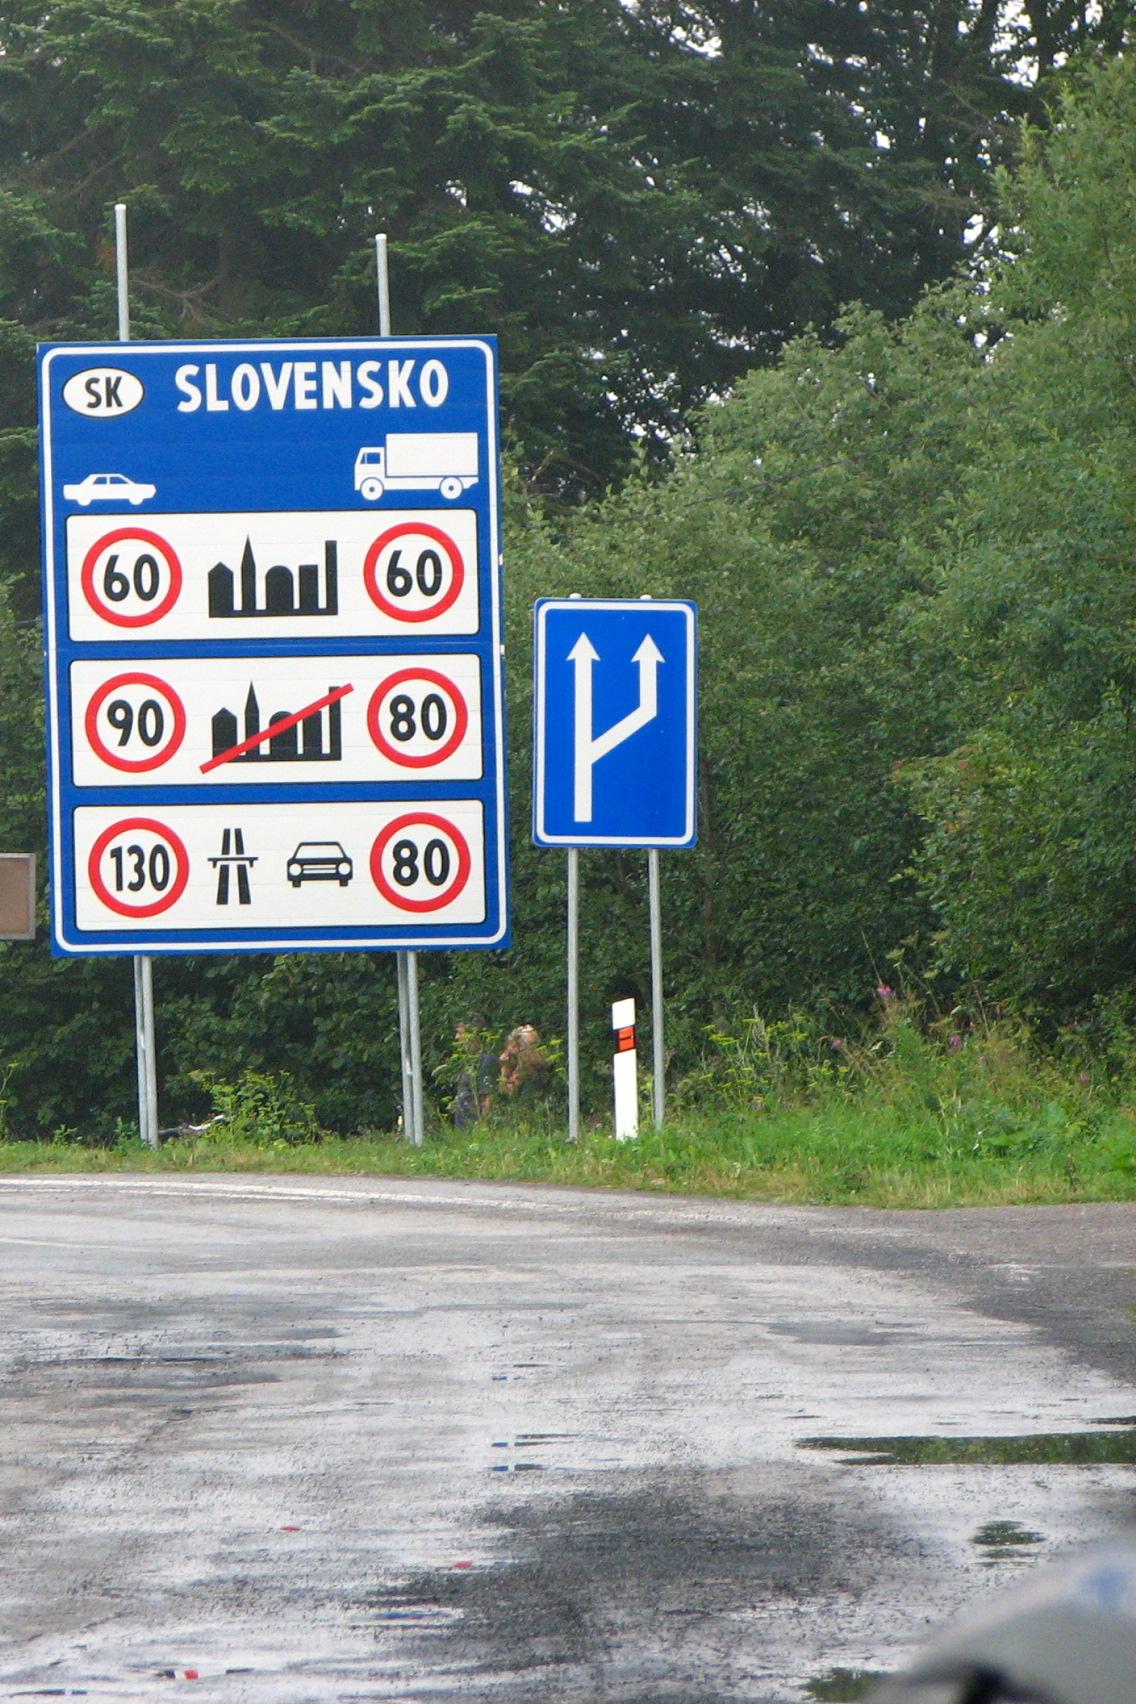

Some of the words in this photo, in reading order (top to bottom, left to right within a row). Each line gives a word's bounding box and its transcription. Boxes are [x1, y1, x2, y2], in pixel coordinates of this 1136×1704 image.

[84, 375, 124, 409] SK
[174, 358, 450, 412] SLOVENSKO
[103, 553, 160, 602] 60
[386, 549, 443, 597] 60
[107, 698, 165, 747] 90
[389, 693, 448, 742] 80
[110, 843, 170, 892] 130
[392, 838, 451, 887] 80
